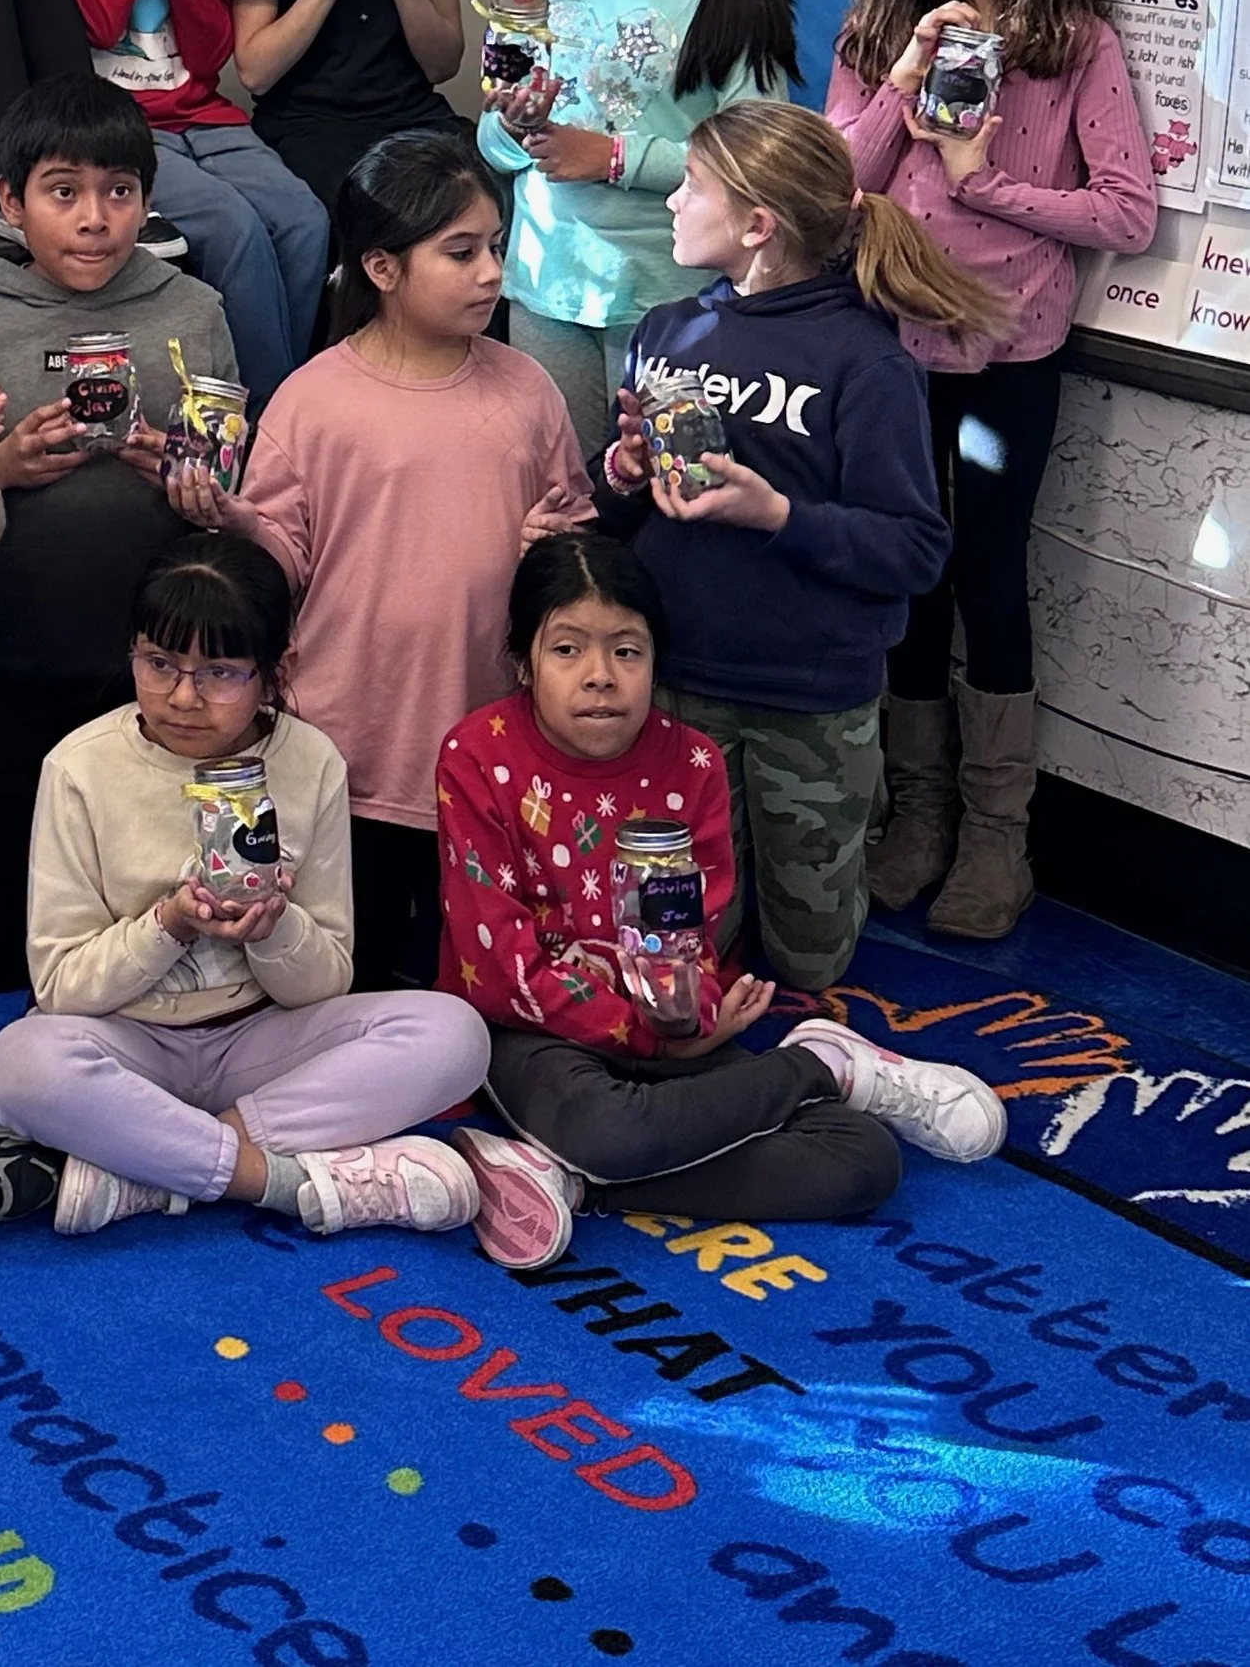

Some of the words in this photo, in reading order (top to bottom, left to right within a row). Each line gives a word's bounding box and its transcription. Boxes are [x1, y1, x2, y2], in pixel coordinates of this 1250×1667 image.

[1135, 12, 1165, 26] suffix
[1192, 19, 1201, 31] to
[1155, 33, 1174, 46] that
[1163, 56, 1174, 66] or
[1155, 72, 1185, 87] plural
[1155, 91, 1188, 110] foxes
[1228, 137, 1244, 154] He
[1106, 285, 1159, 309] once
[1190, 290, 1250, 332] know
[661, 910, 690, 922] Jar
[811, 1298, 1105, 1443] YOU
[321, 1265, 698, 1512] LOVED
[710, 1541, 970, 1667] an
